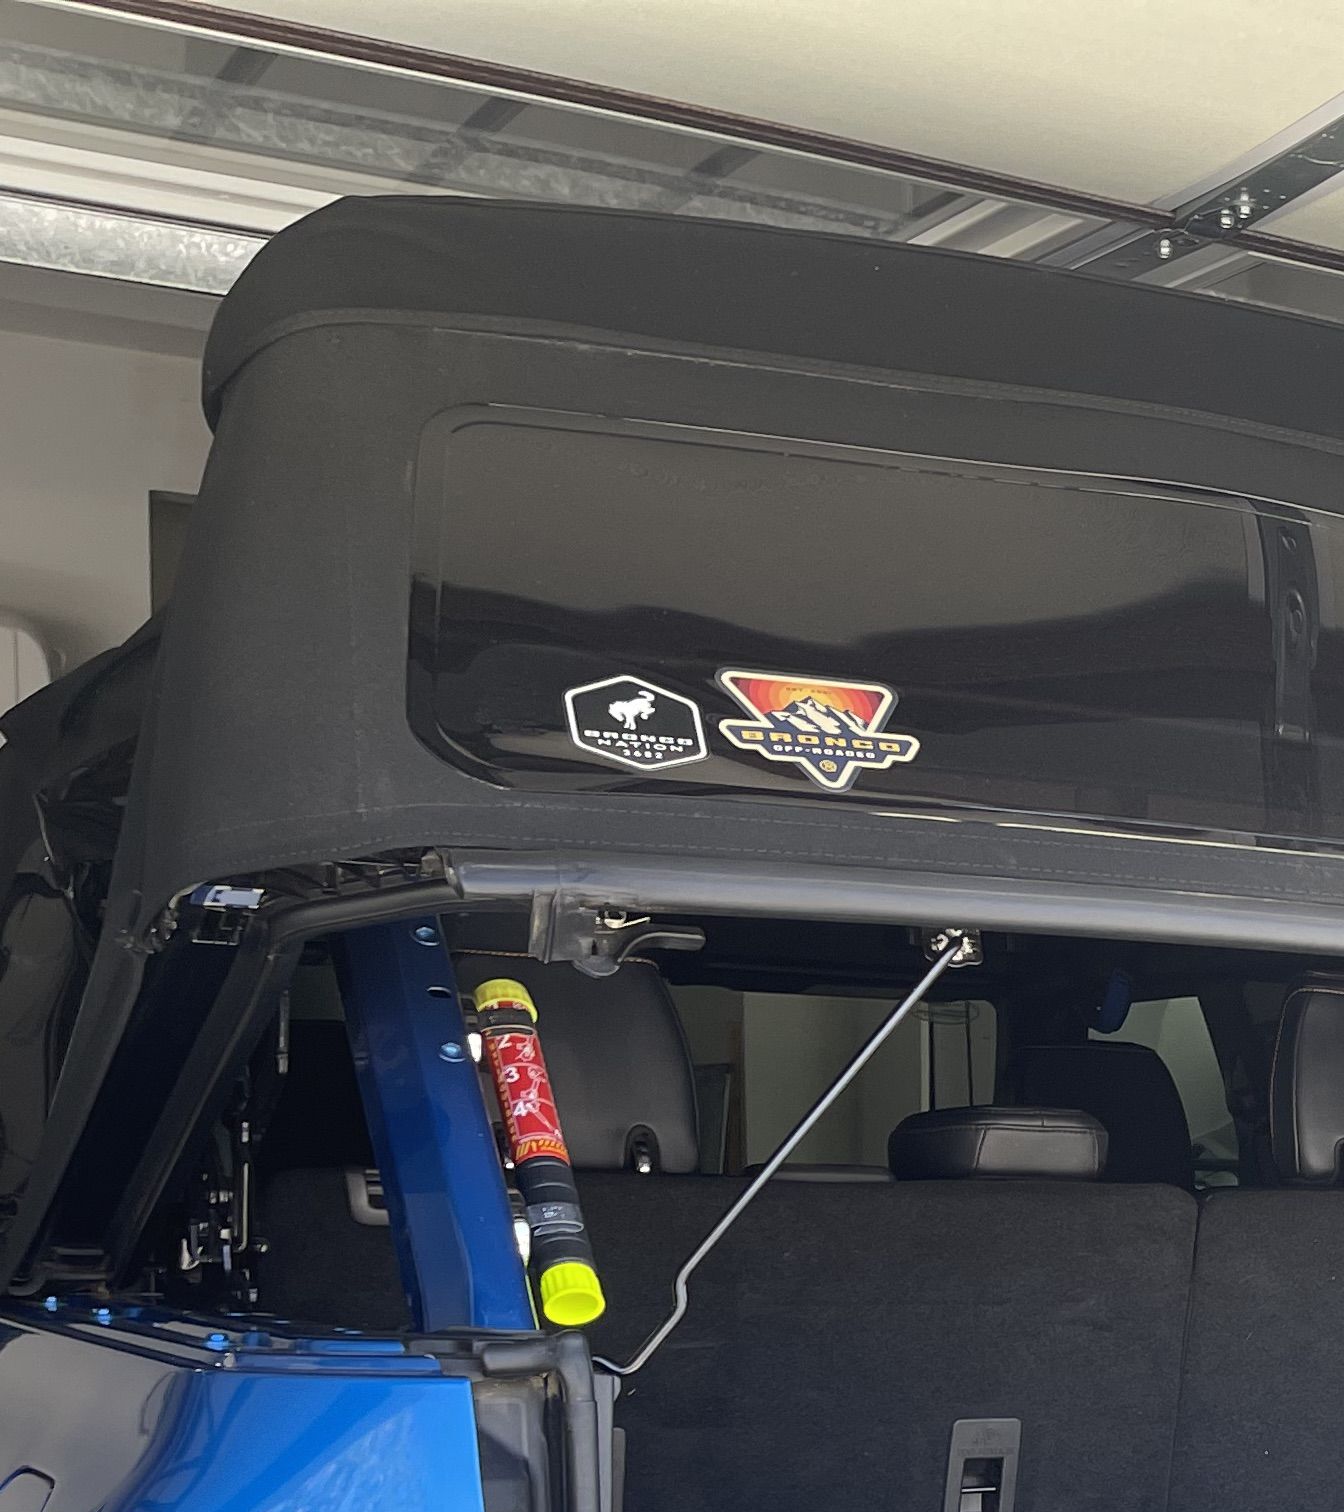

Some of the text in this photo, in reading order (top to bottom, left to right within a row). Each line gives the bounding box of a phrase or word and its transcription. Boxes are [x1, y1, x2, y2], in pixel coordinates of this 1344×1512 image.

[583, 730, 694, 746] BRONCO
[597, 739, 684, 753] NATION
[742, 731, 901, 752] BRONCO
[504, 1067, 520, 1083] 3
[512, 1101, 527, 1117] 4
